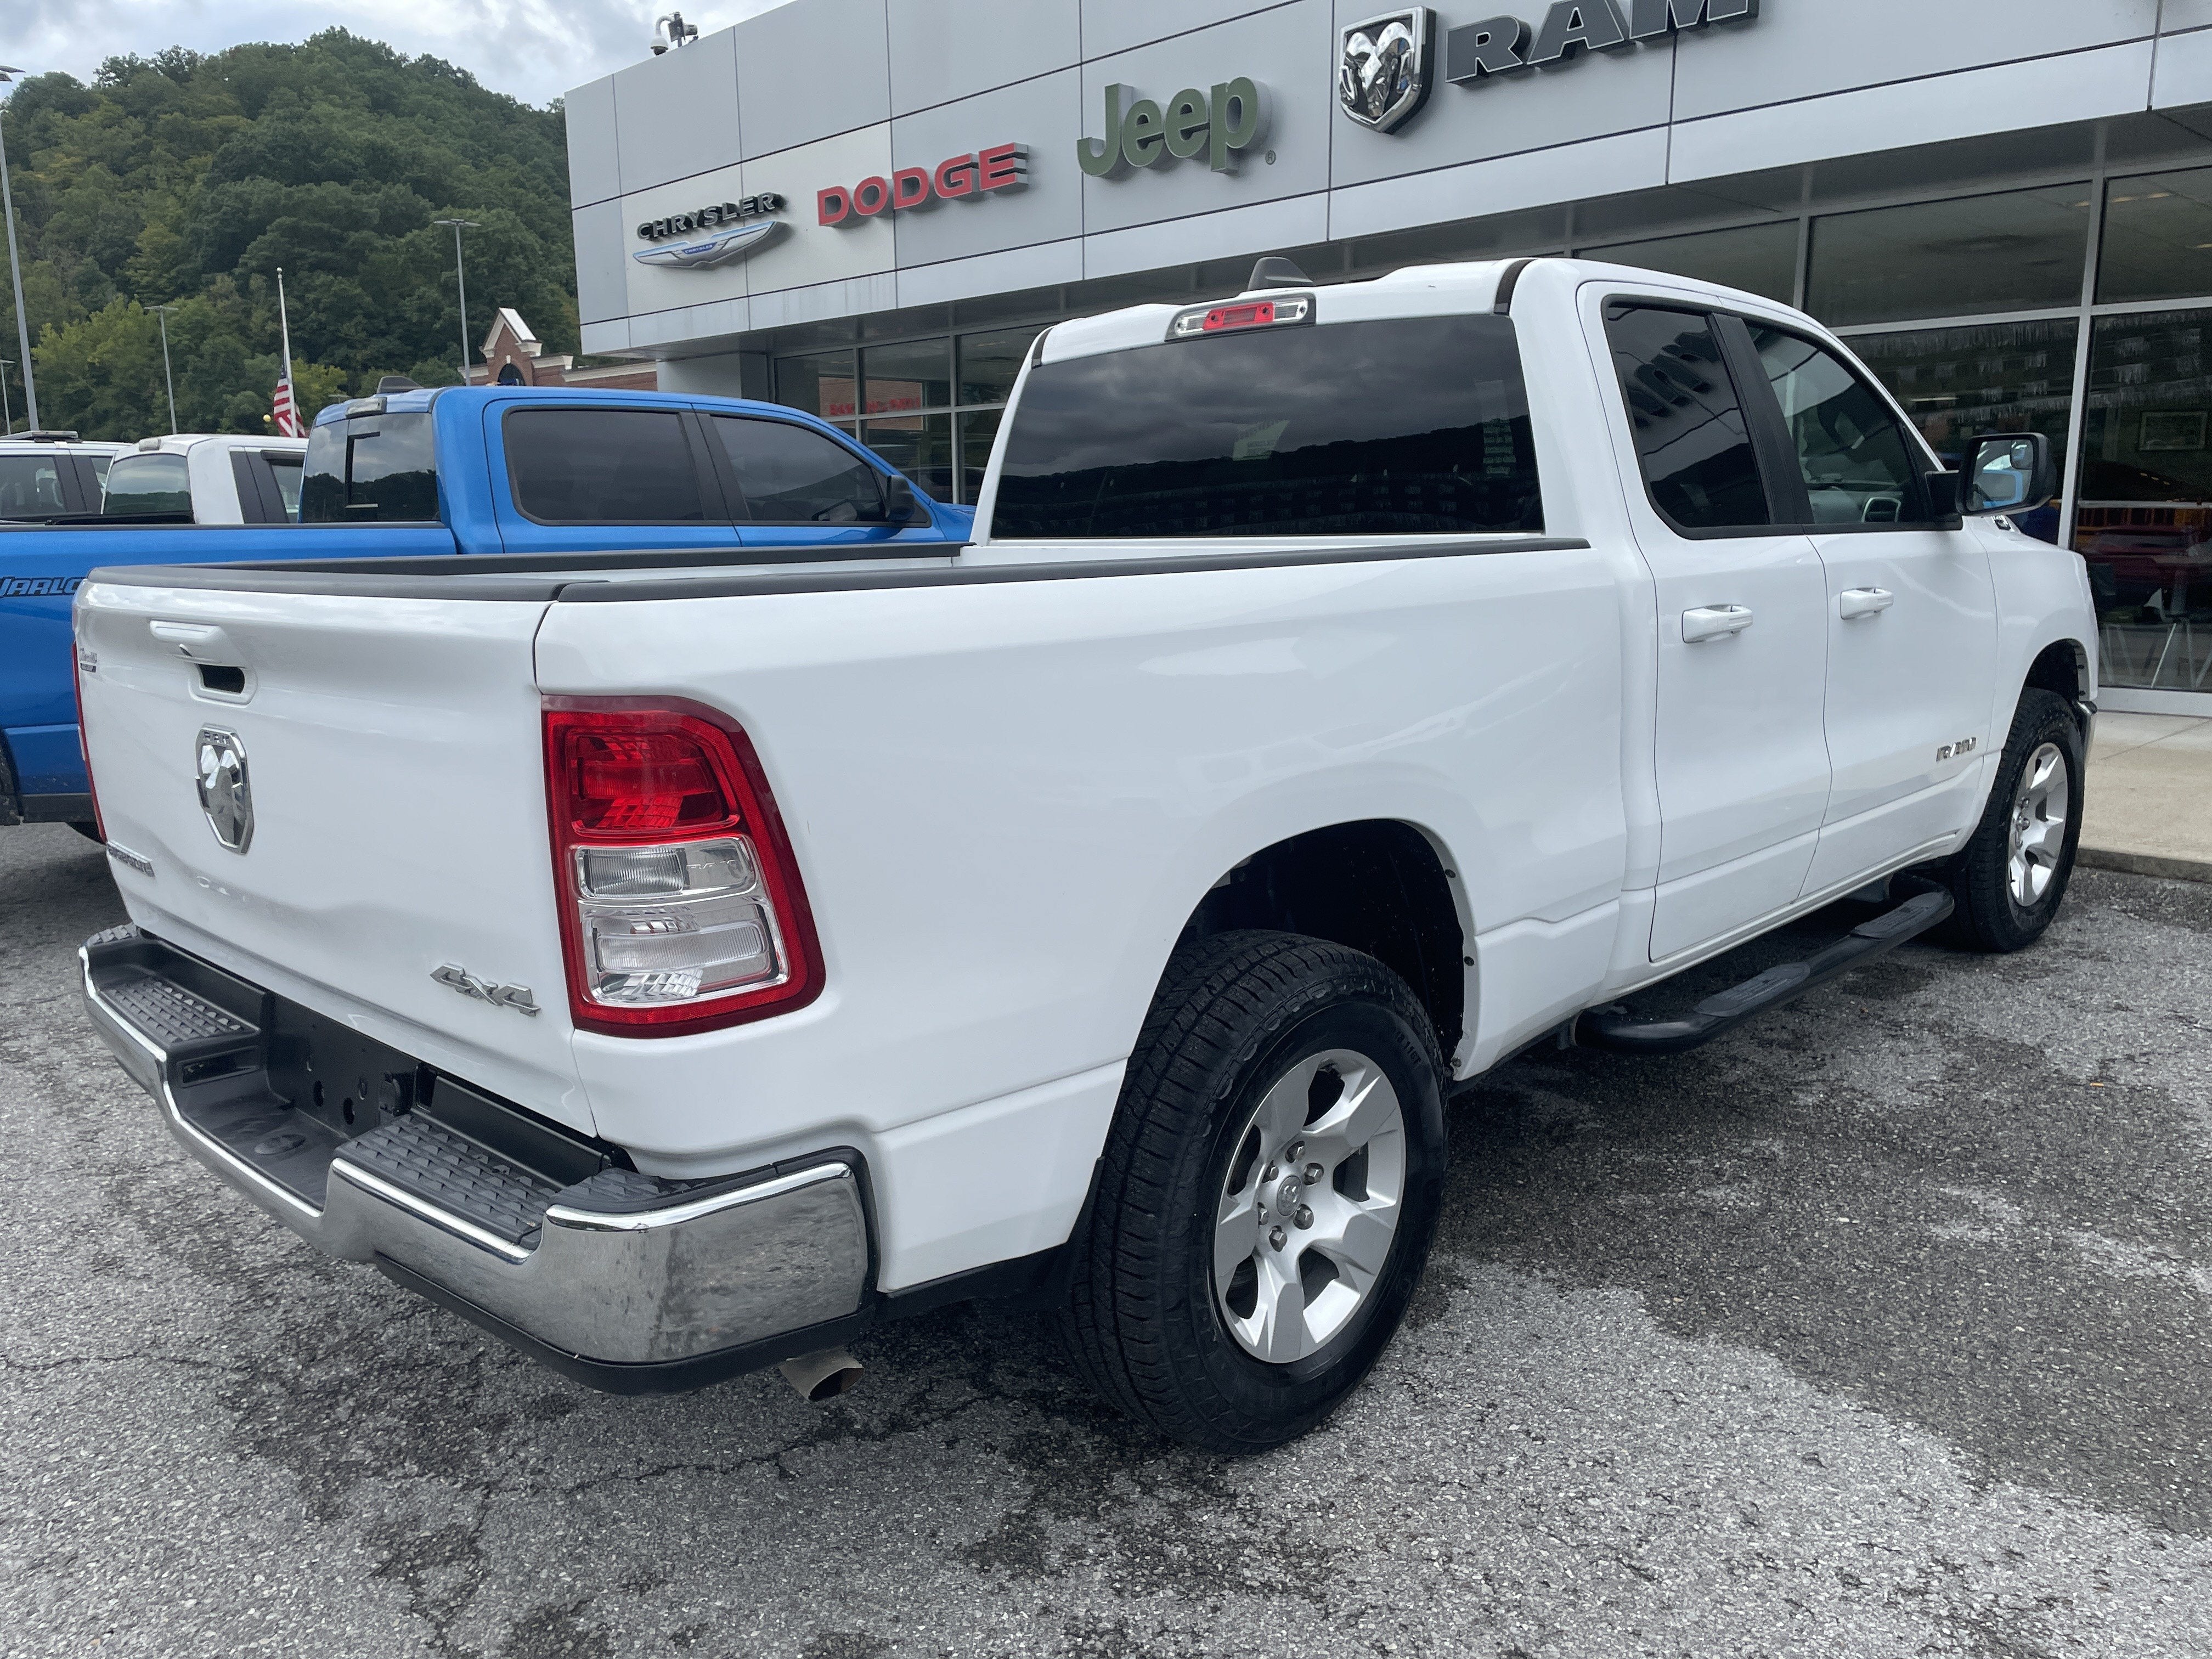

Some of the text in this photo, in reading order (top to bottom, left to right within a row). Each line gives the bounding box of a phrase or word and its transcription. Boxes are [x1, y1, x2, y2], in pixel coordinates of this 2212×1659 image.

[1444, 0, 1756, 83] RAM
[1077, 76, 1264, 177] Jeep
[636, 191, 780, 240] CHRYSLER
[817, 142, 1027, 227] DODGE
[203, 730, 231, 746] RAM
[1936, 736, 1977, 762] RAM
